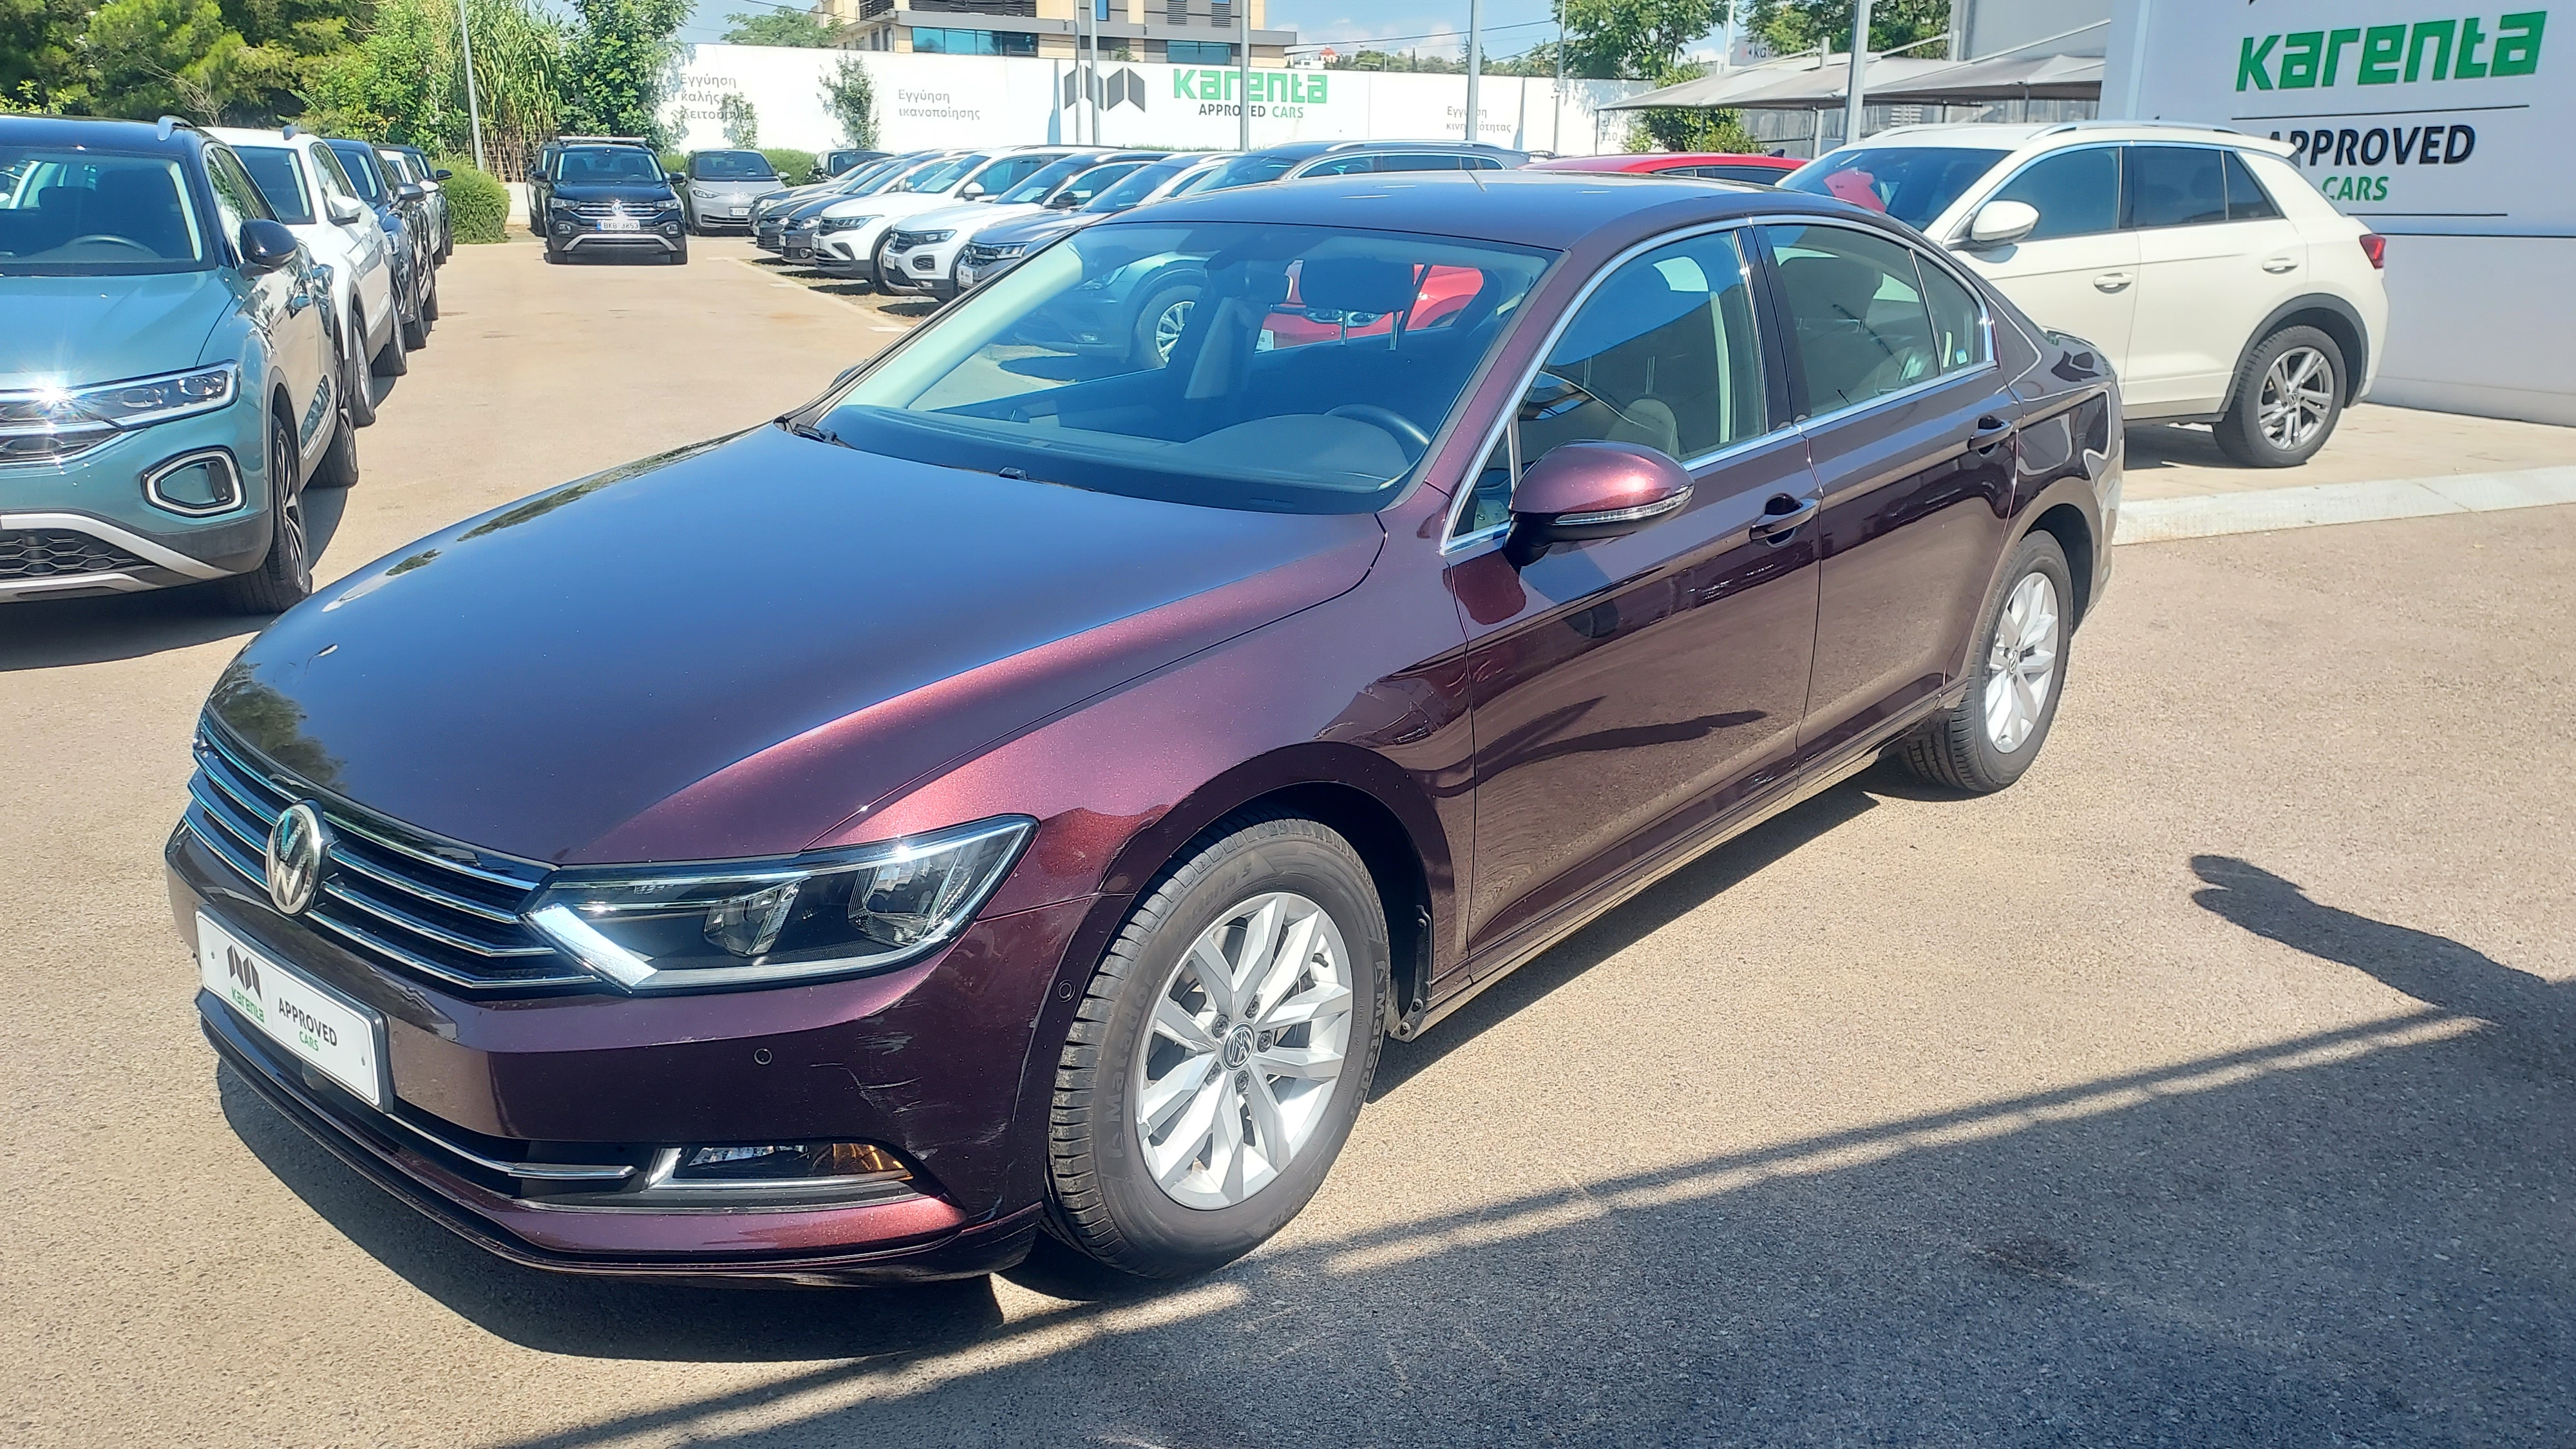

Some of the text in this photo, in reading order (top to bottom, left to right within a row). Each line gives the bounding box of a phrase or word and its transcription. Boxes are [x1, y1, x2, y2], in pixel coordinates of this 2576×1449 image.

[680, 73, 736, 88] Εγγύηση
[898, 90, 950, 104] Εγγύηση
[899, 106, 980, 120] ικανοποίησης
[1198, 104, 1303, 118] APPROED CARS
[1447, 106, 1487, 118] Εγγση
[1446, 121, 1511, 133] κινηότητας
[2269, 124, 2476, 166] PPROVED
[2322, 176, 2389, 201] CARS
[279, 997, 337, 1046] APPROVED
[299, 1031, 319, 1052] CARS
